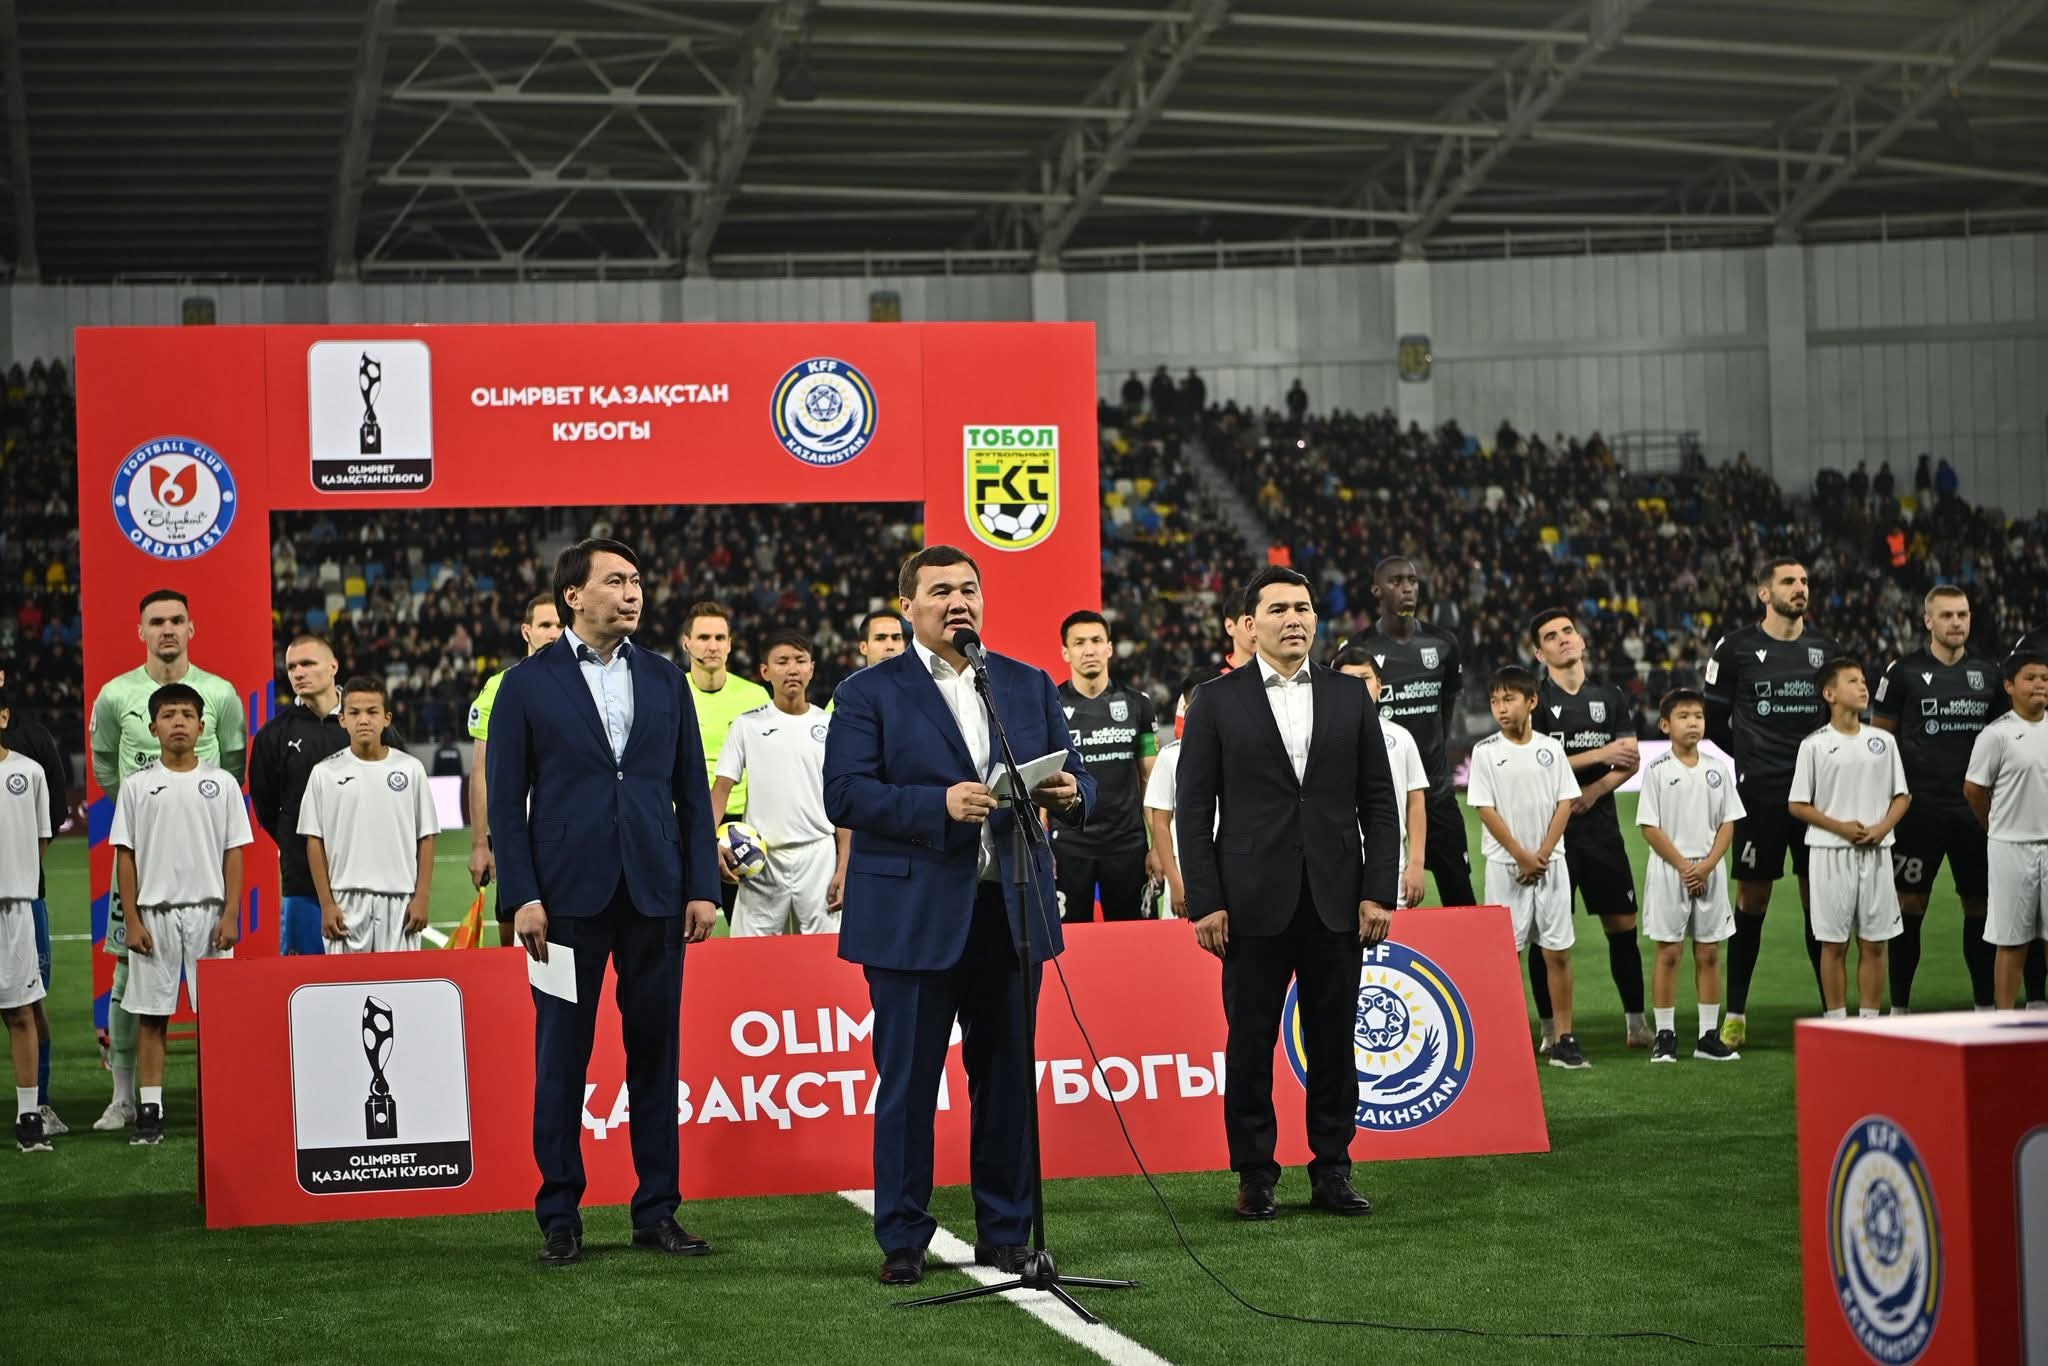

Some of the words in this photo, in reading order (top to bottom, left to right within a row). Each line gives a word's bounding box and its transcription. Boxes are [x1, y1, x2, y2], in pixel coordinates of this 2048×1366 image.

[807, 360, 837, 373] KFF
[471, 386, 584, 407] OLIMPBET
[589, 384, 729, 408] ҚАЗАҚСТАН
[552, 421, 650, 441] КУБОГЫ
[968, 428, 1053, 447] ТОБОЛ
[123, 441, 185, 477] FOOTBALL
[193, 446, 223, 473] CLUB
[785, 436, 866, 464] KAZAKHSTAN
[347, 464, 395, 475] OLIMPBET
[321, 474, 380, 486] ҚАЗАҚСТАН
[382, 473, 424, 484] КУБОГЫ
[130, 524, 223, 558] ORDABASY
[1083, 735, 1132, 746] resources
[1091, 726, 1136, 738] solidcore
[1741, 840, 1757, 869] 4
[1362, 944, 1390, 962] FF
[350, 1152, 417, 1167] OLIMPBET
[312, 1168, 397, 1184] ҚАЗАҚСТАН
[400, 1164, 459, 1177] КУБОГЫ
